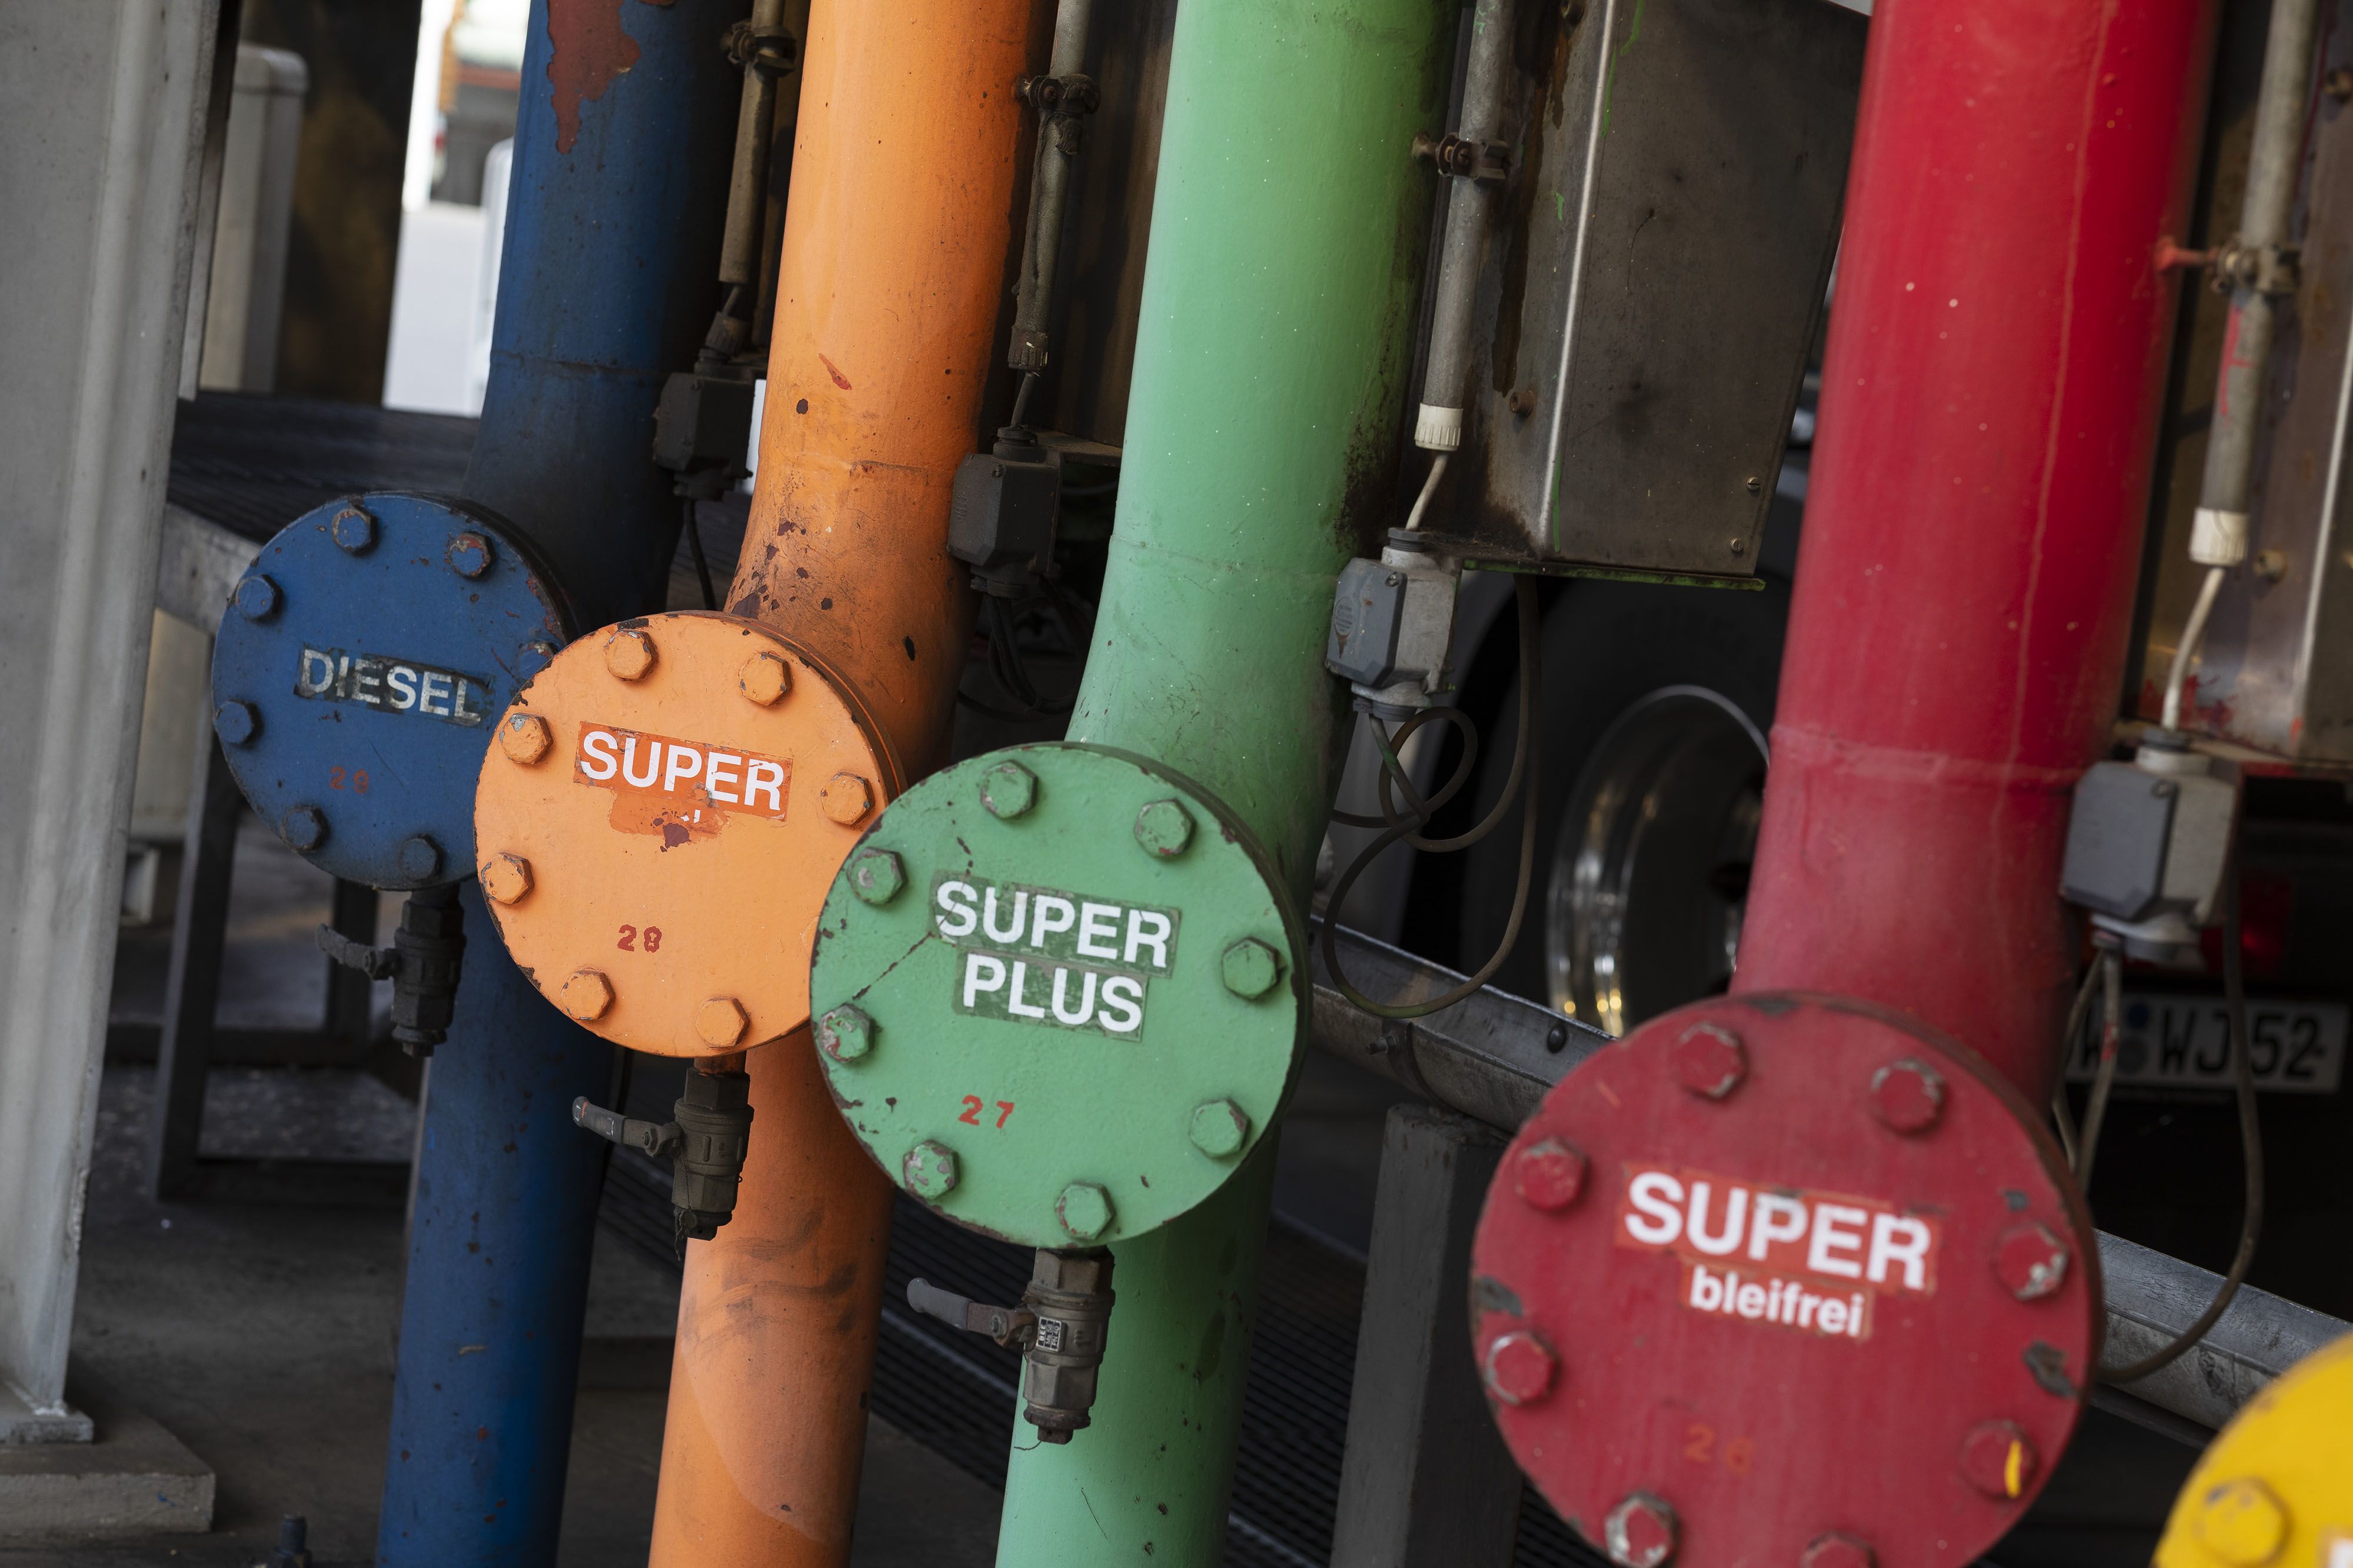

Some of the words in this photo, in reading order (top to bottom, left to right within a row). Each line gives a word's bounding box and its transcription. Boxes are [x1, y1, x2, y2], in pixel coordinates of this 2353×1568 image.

[299, 648, 482, 726] DIESEL
[329, 766, 370, 794] 29
[580, 730, 784, 811] SUPER
[616, 924, 662, 953] 28
[935, 880, 1171, 968] SUPER
[962, 953, 1143, 1033] PLUS
[2251, 1013, 2320, 1079] 52
[958, 1095, 1015, 1129] 27
[1624, 1171, 1932, 1291] SUPER
[1688, 1264, 1865, 1337] bleifrei
